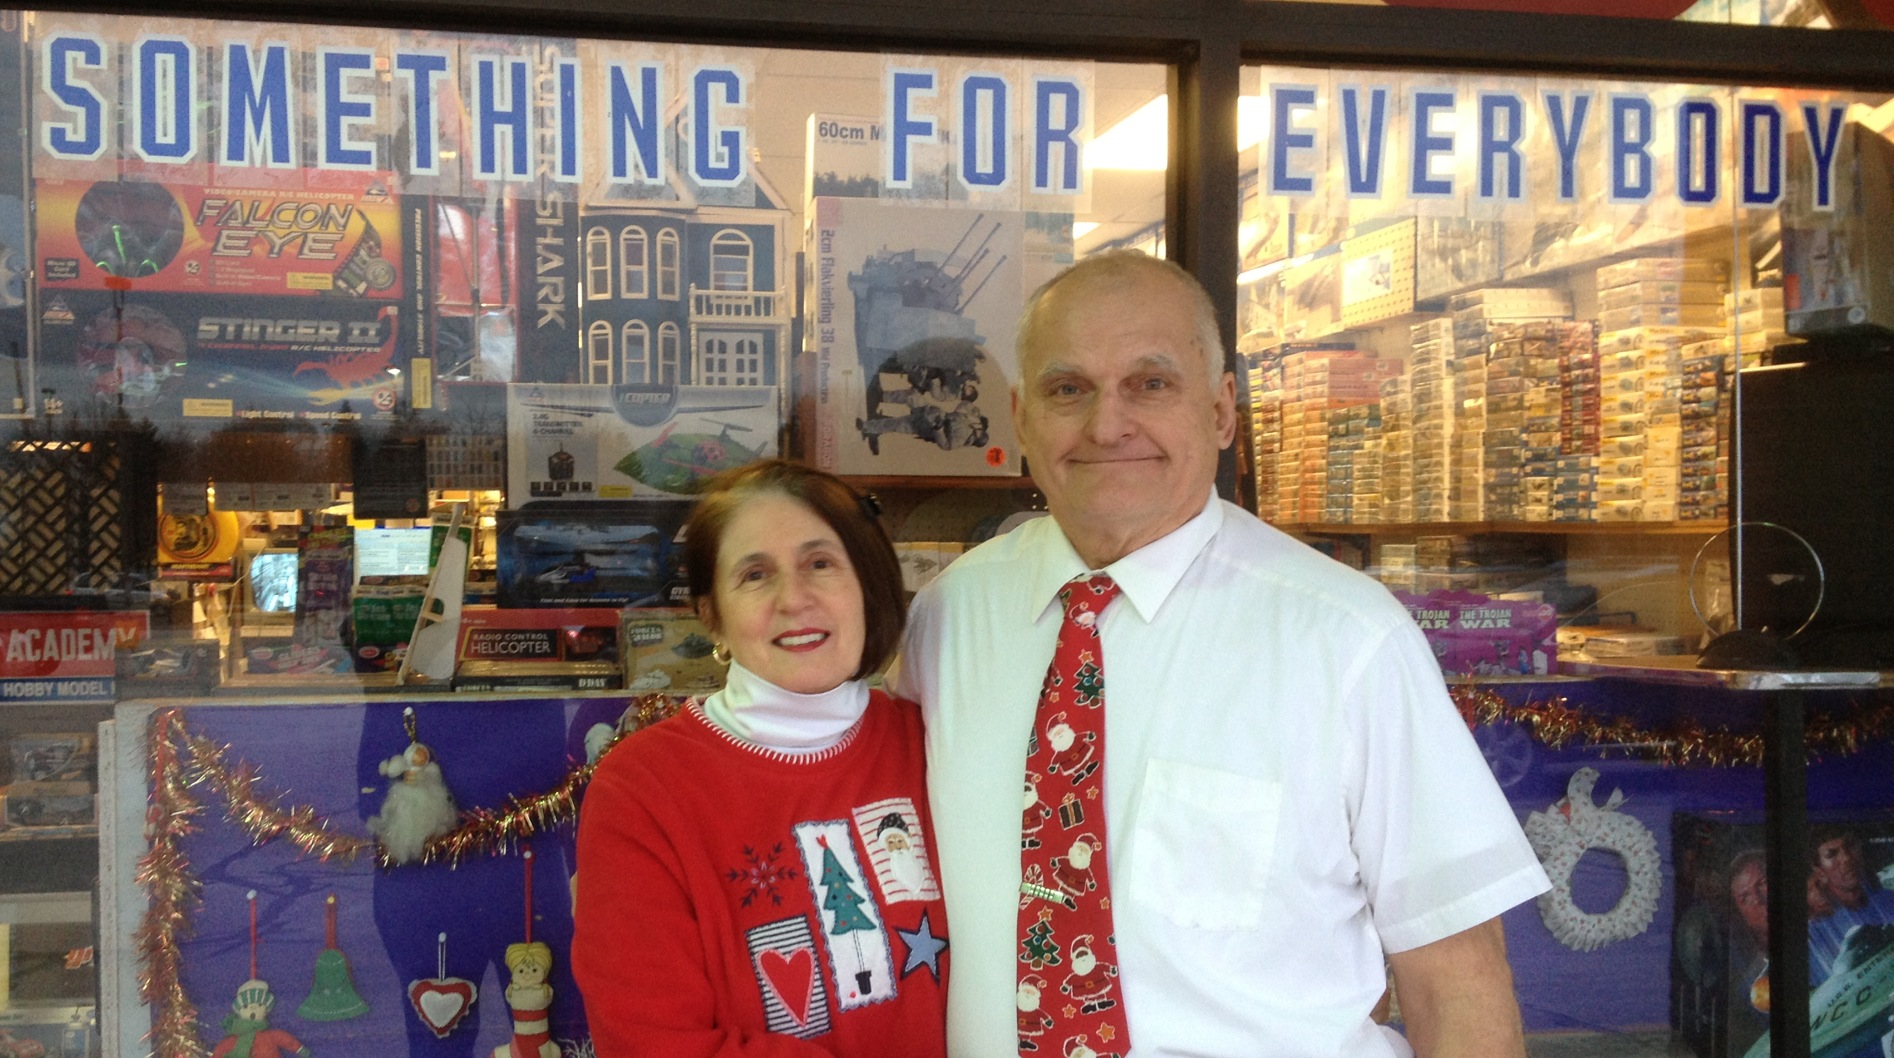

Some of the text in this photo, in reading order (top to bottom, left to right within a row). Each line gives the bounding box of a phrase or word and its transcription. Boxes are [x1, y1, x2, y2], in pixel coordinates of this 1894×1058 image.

[41, 32, 1849, 212] SOMETHING FOR EVERYBODY
[818, 121, 865, 141] 60cm
[196, 199, 353, 231] FALCON
[212, 229, 344, 260] EYE
[820, 229, 835, 254] 2cm
[535, 190, 565, 330] SHARK
[197, 317, 383, 344] STINGER II
[820, 327, 835, 344] 38
[313, 344, 382, 353] HELICOPTER
[670, 586, 691, 594] GYR
[1417, 609, 1450, 619] TROJAN
[1459, 608, 1476, 619] THE
[1479, 608, 1511, 619] TROJAN
[1418, 619, 1450, 629] AR
[1459, 619, 1511, 629] WAR
[473, 632, 548, 641] RADIO CONTROL
[471, 640, 551, 654] HELICOPTER
[4, 682, 54, 697] HOBBY
[57, 681, 109, 696] MODEL
